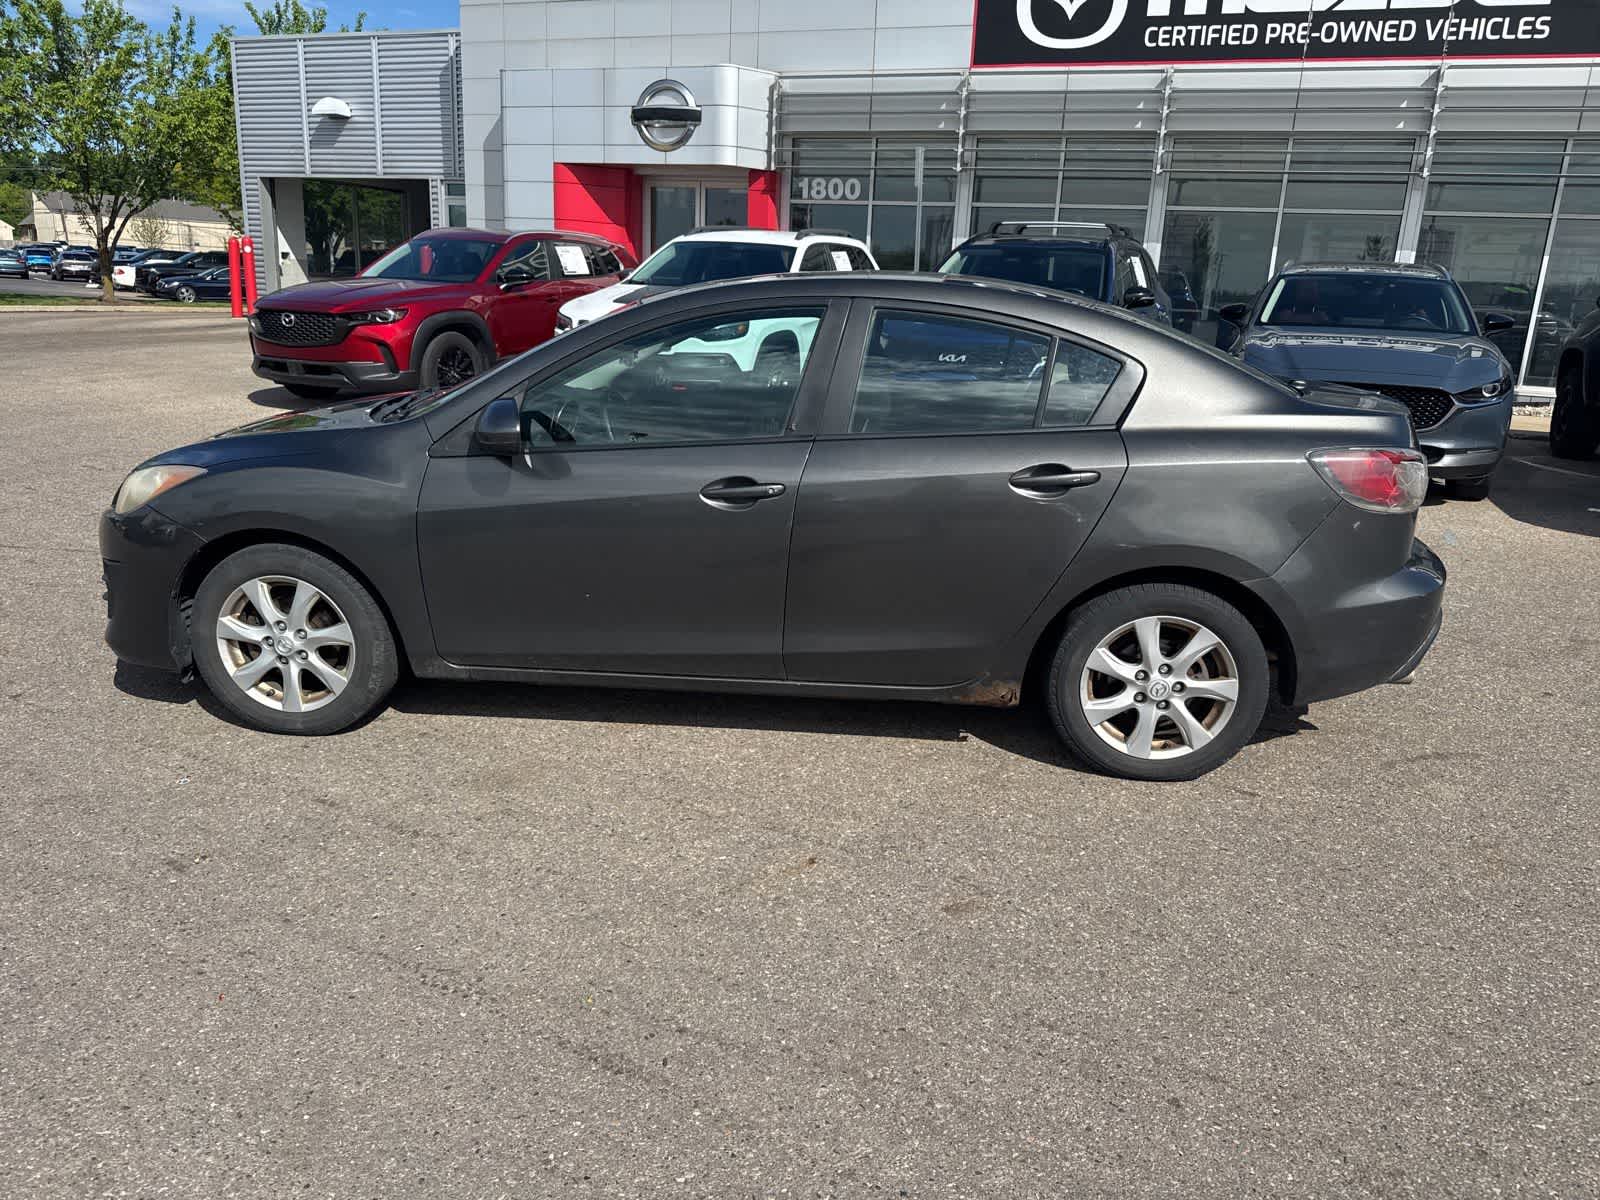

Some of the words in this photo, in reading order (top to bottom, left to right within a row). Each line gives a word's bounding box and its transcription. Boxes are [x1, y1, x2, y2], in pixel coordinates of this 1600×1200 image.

[1144, 23, 1259, 48] CERTIFIED
[1264, 20, 1417, 45] PRE-OWNED
[1425, 16, 1552, 42] VEHICLES
[798, 177, 861, 200] 1800
